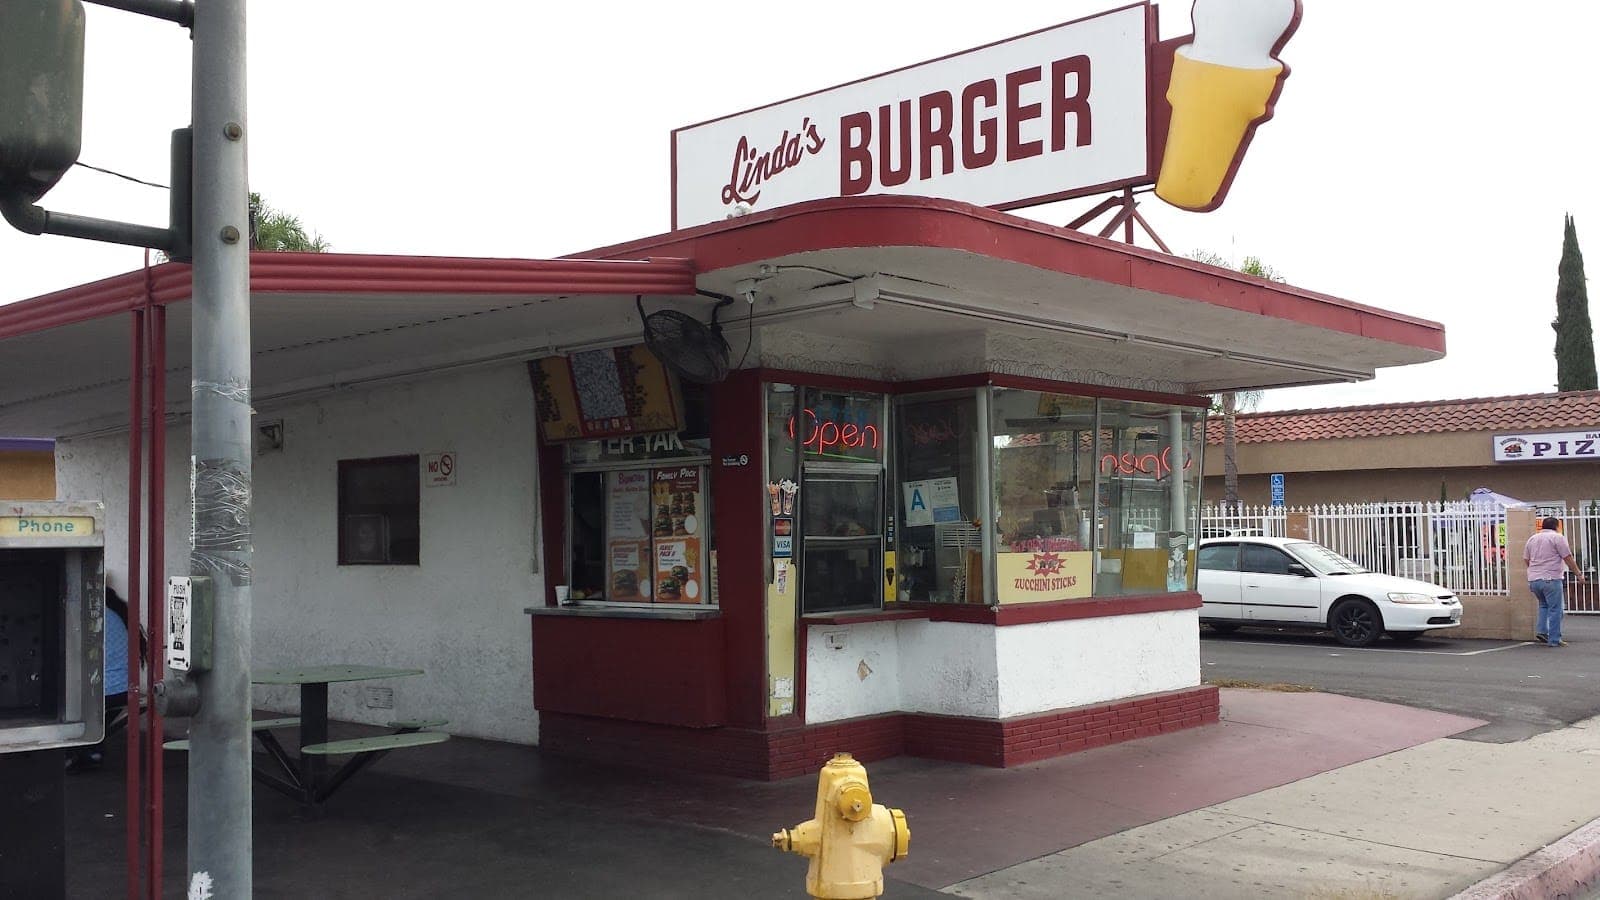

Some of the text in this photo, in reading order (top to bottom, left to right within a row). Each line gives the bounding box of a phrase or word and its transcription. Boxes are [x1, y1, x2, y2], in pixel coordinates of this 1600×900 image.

[721, 54, 1092, 205] Linda's BURGER
[788, 408, 877, 455] Open
[428, 461, 438, 472] NO
[911, 489, 926, 511] A
[18, 519, 74, 532] Phone
[776, 540, 791, 549] VISA
[173, 584, 186, 594] PUSH
[1014, 576, 1077, 591] ZUCCHINI STICKS
